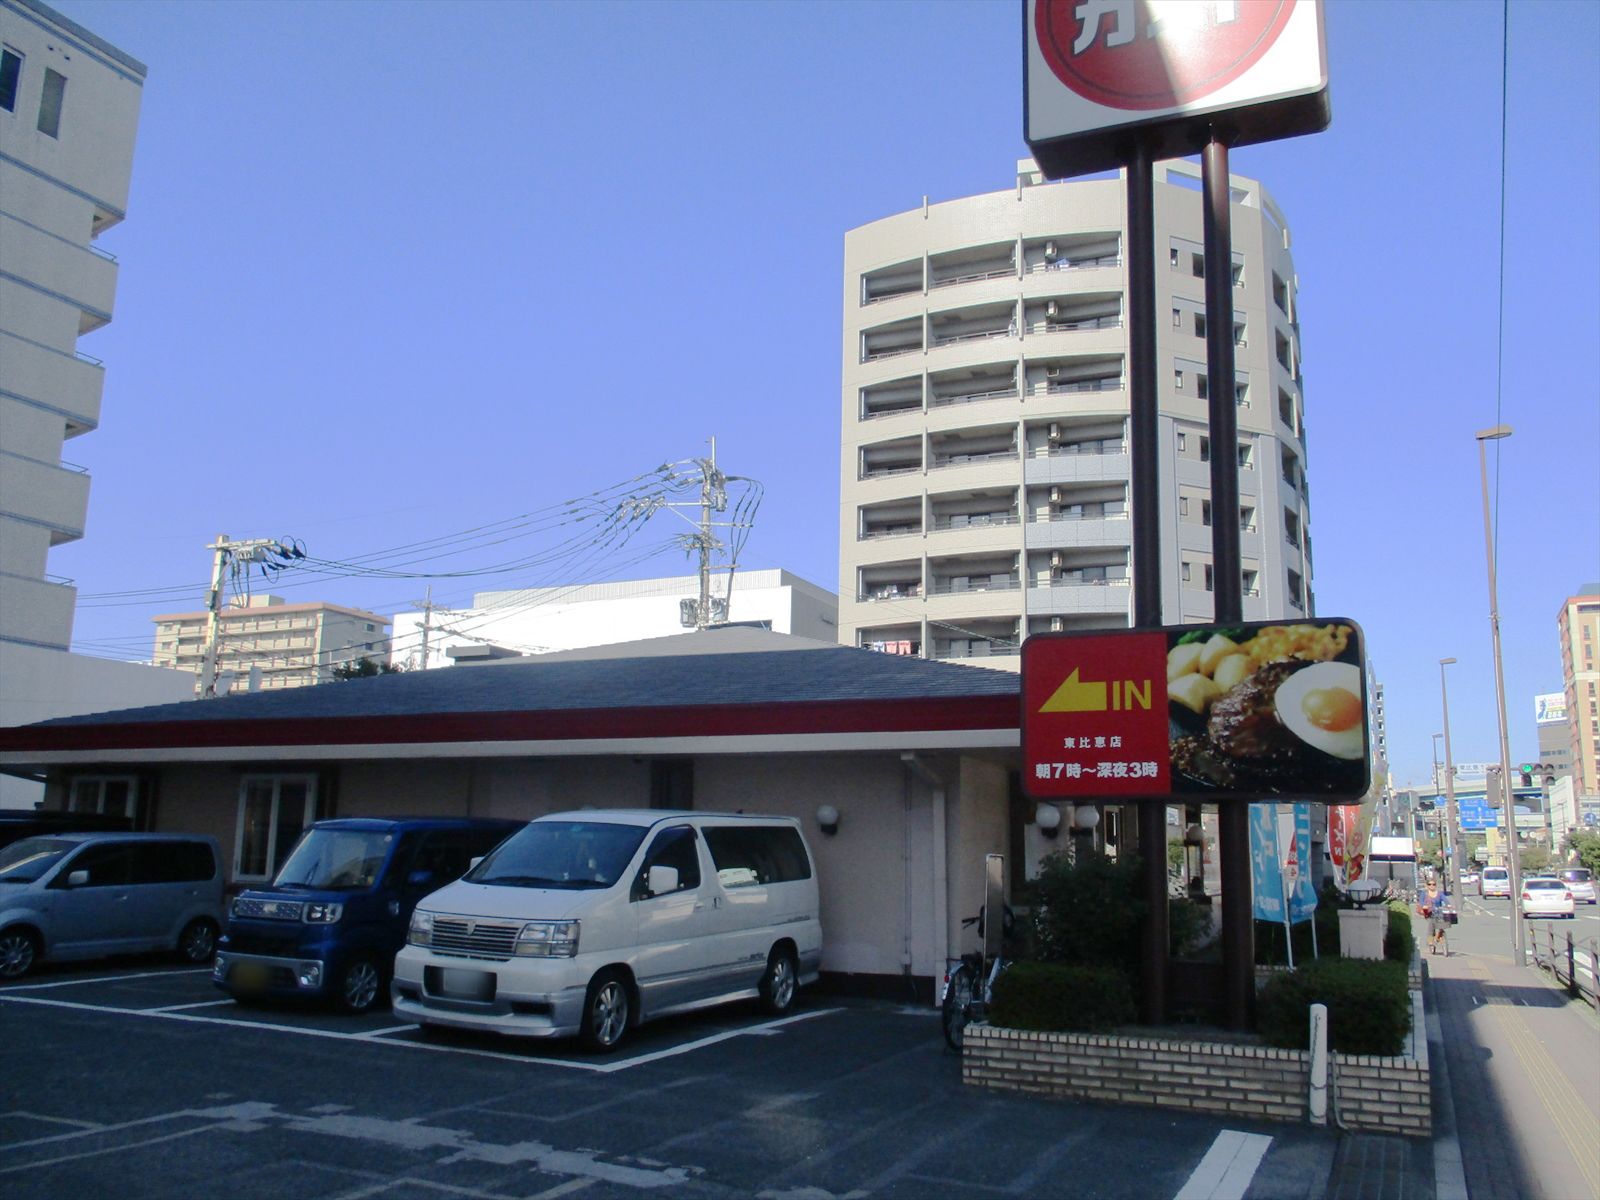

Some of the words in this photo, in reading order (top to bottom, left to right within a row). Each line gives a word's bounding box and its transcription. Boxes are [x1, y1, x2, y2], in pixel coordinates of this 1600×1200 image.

[1112, 679, 1152, 711] IN
[1063, 735, 1122, 749] 東比恵店
